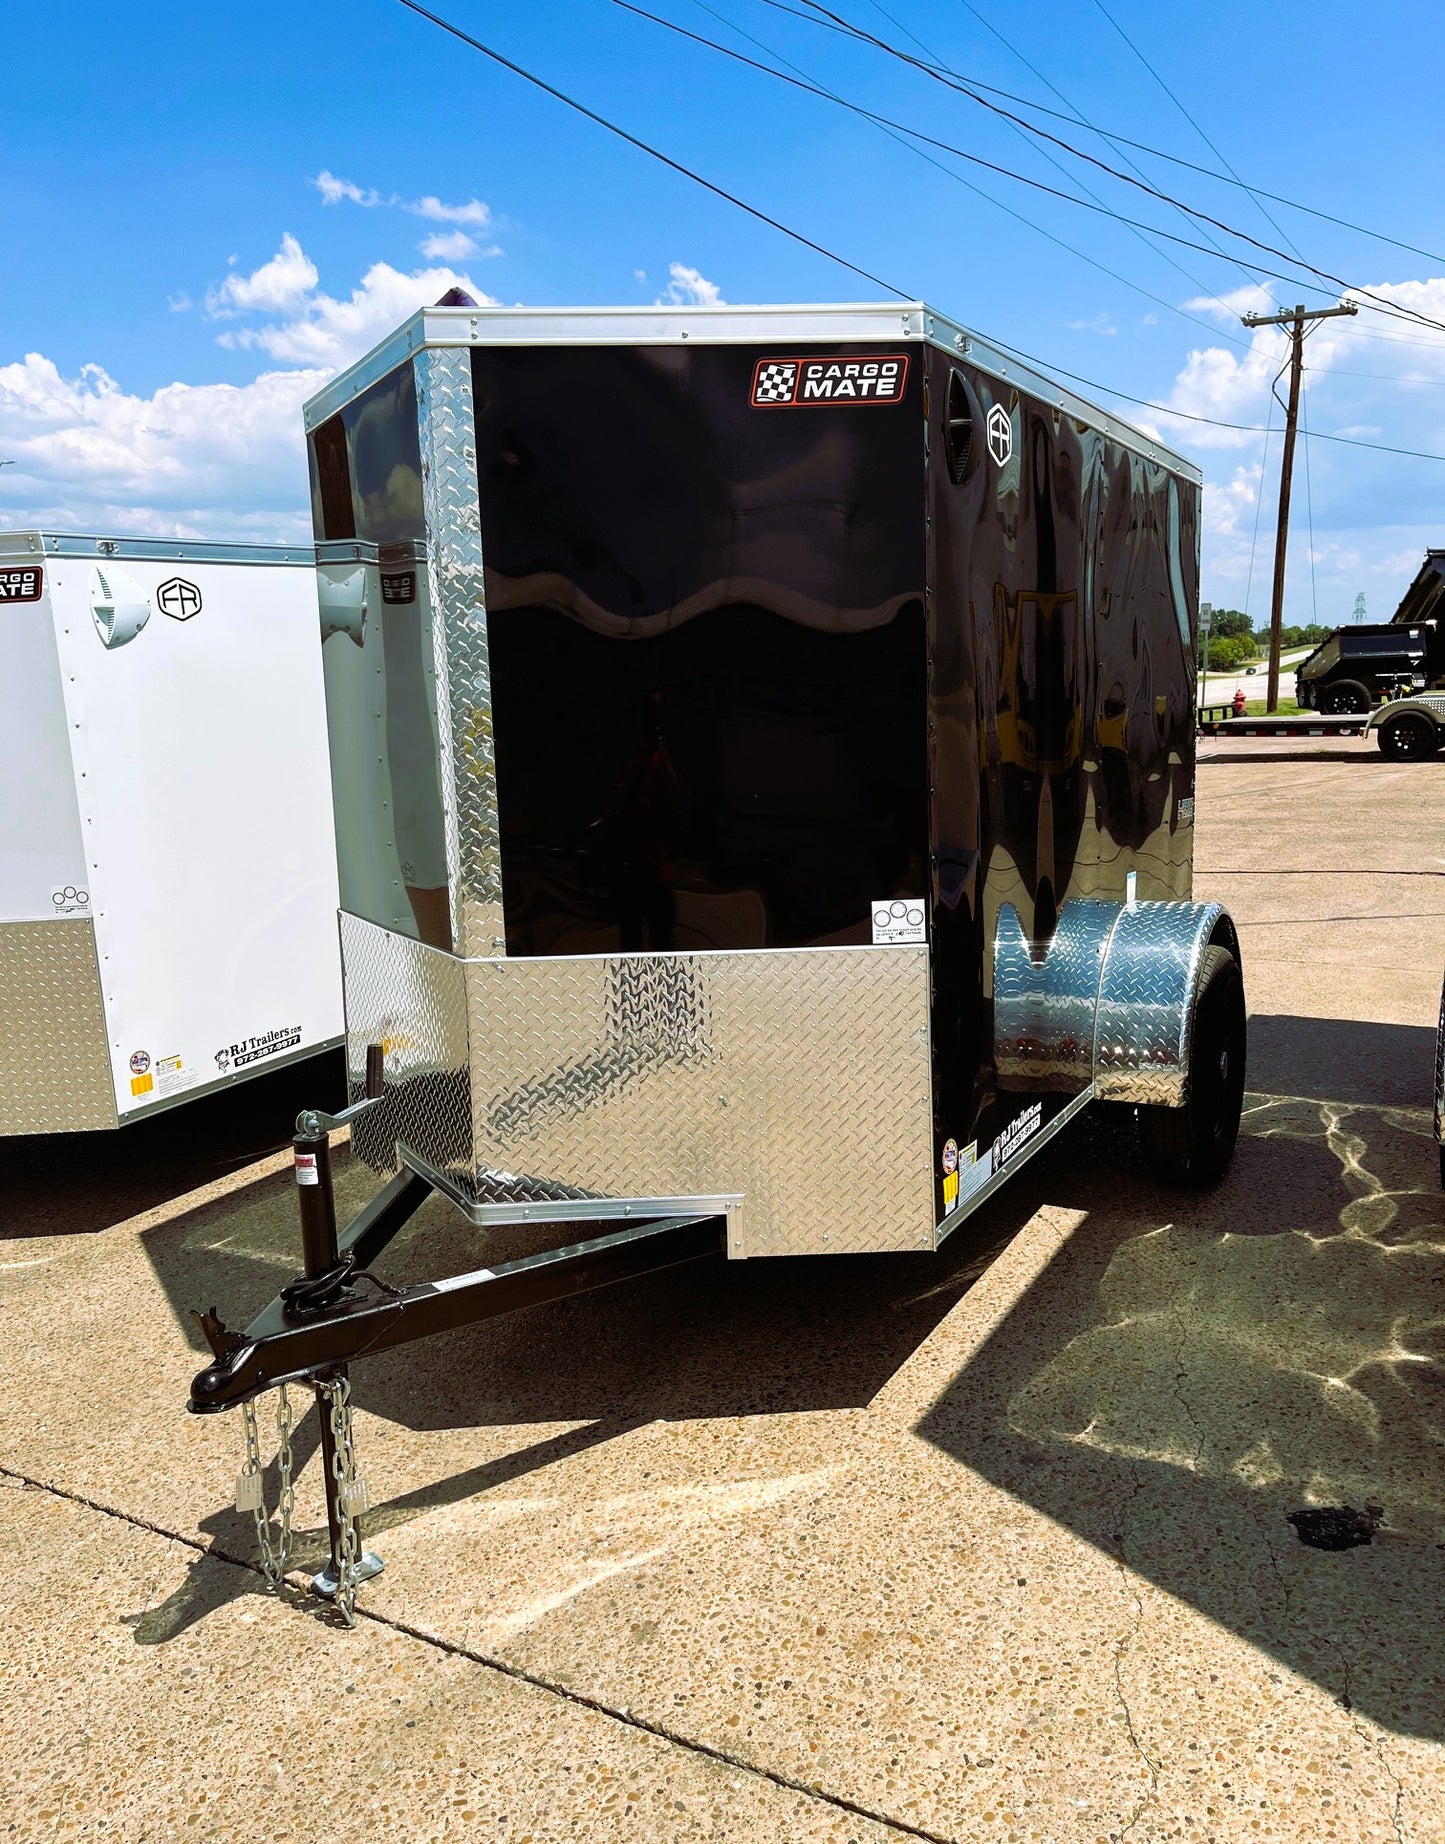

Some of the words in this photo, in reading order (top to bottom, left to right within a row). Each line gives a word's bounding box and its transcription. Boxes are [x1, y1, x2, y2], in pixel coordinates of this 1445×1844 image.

[807, 362, 898, 379] CARGO
[803, 377, 897, 398] MATE
[229, 1040, 247, 1057] RJ
[248, 1027, 290, 1049] Trailers
[236, 1036, 299, 1066] 972-287-9977
